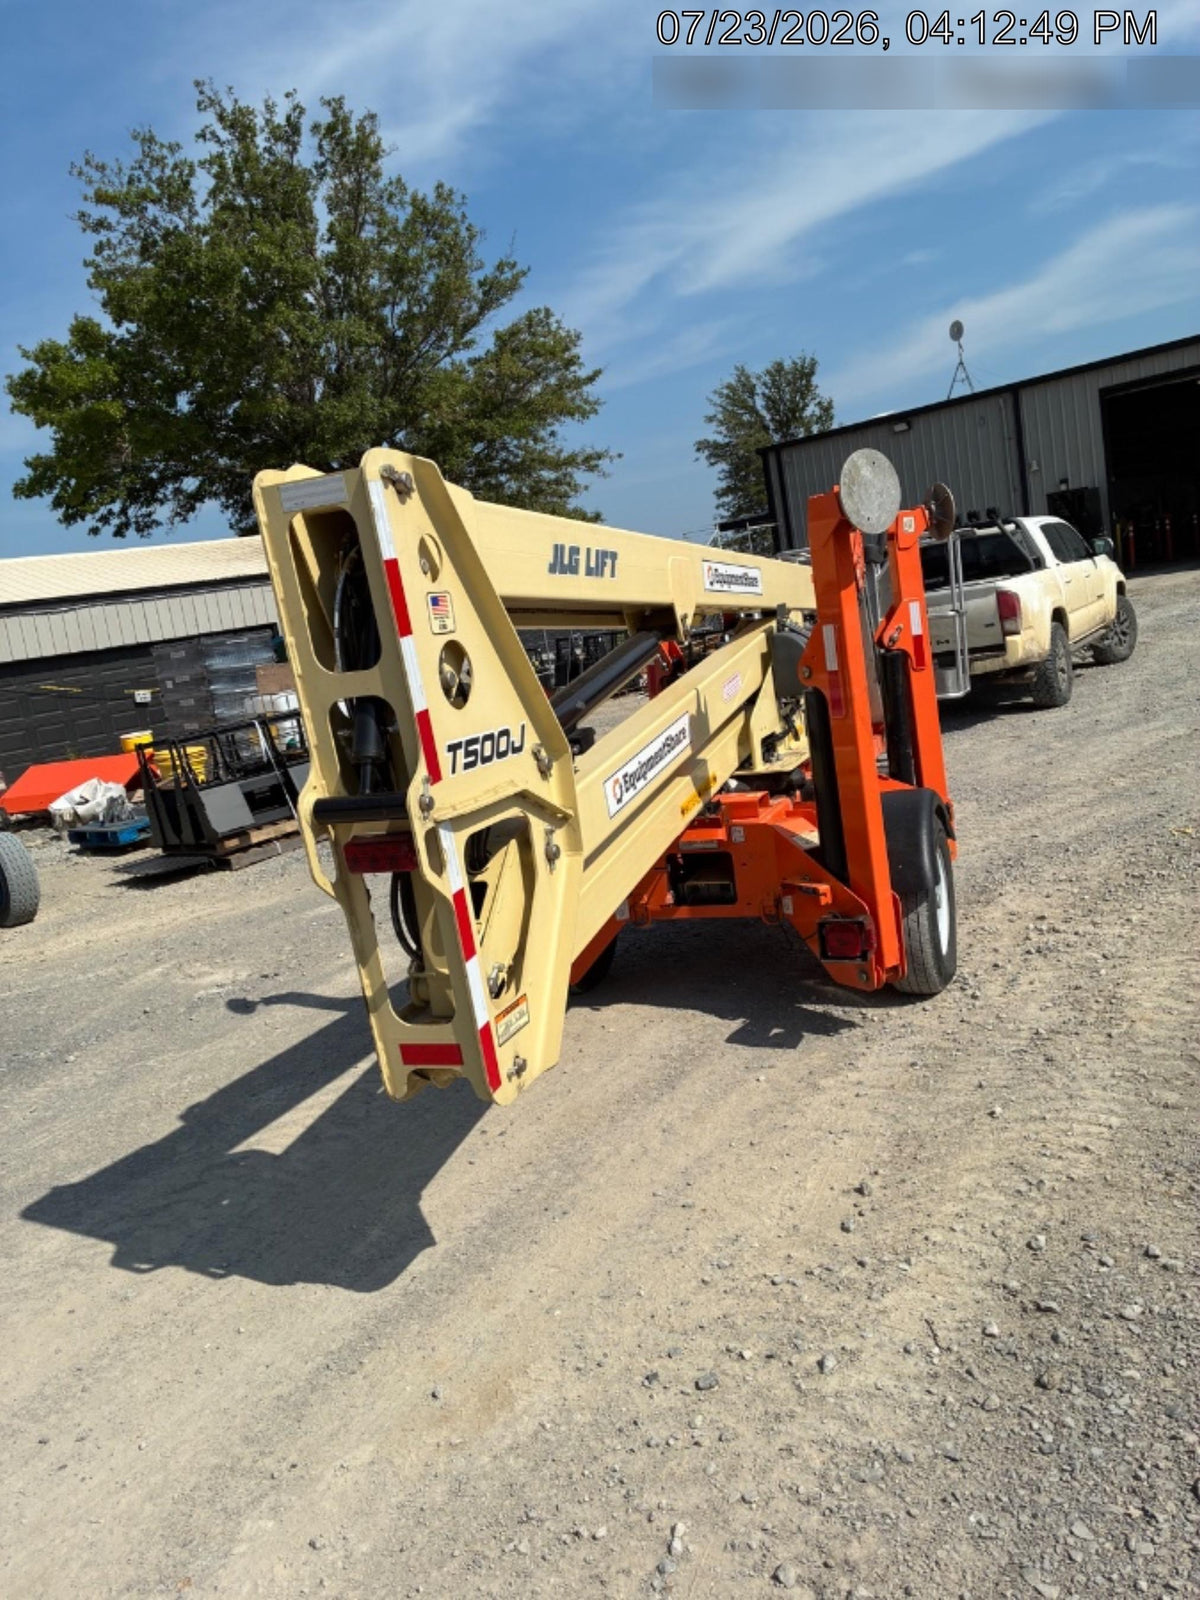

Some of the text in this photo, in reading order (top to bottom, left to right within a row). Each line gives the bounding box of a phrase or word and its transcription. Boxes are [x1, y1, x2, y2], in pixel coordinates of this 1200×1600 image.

[548, 543, 618, 578] JLG LIFT
[446, 722, 526, 776] T500J
